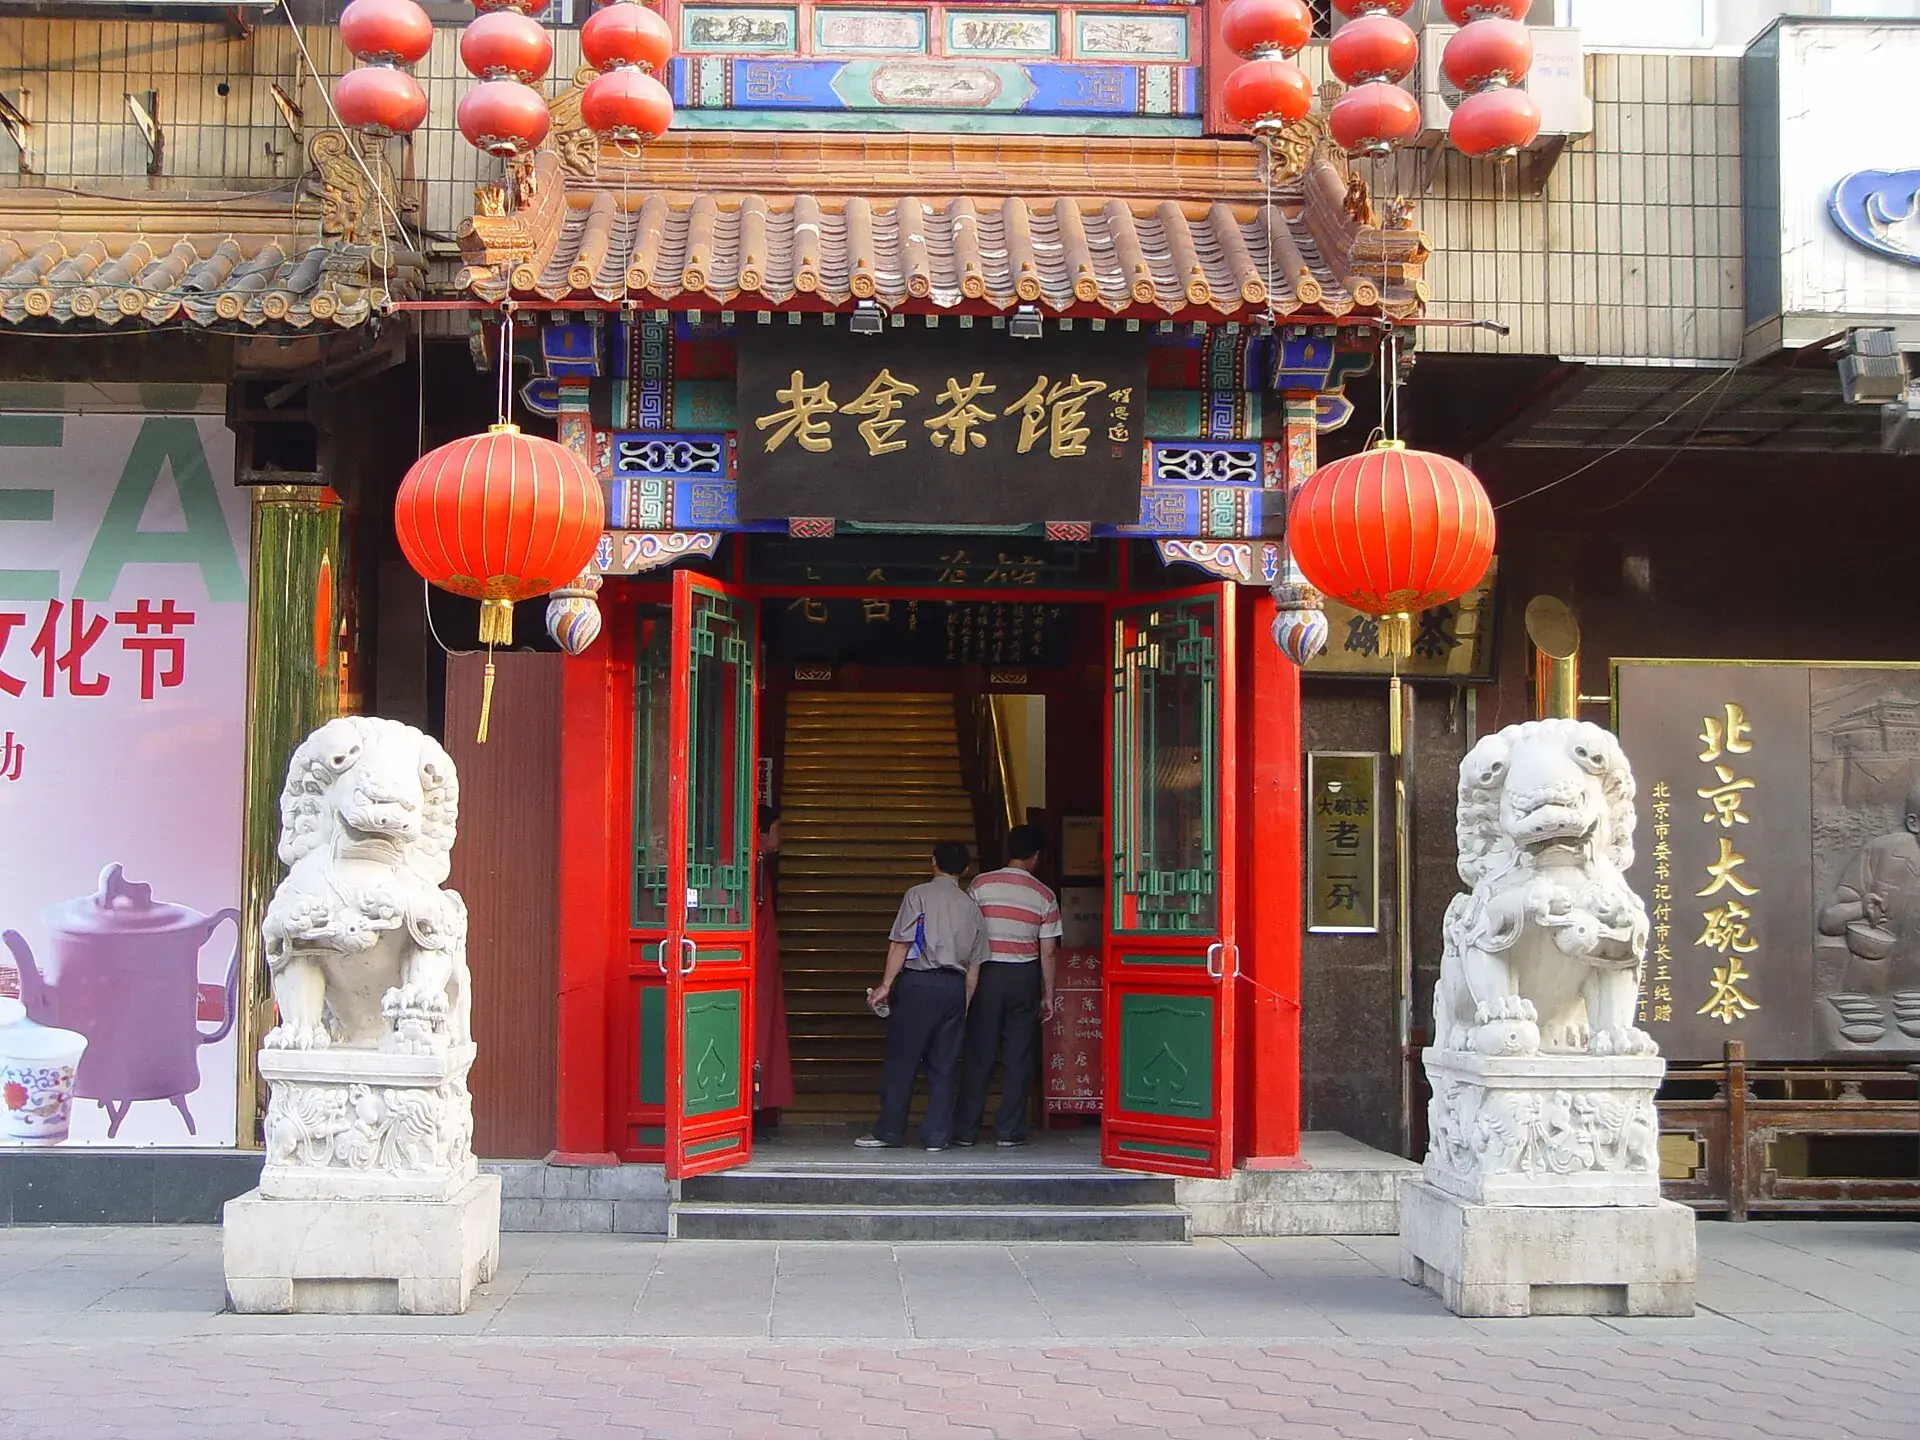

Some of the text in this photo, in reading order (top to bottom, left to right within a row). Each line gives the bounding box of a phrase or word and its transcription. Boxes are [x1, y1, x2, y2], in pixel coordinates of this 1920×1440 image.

[1317, 797, 1369, 816] 大碗茶
[1651, 781, 1673, 1022] 北京市委书记付市长王纯赠
[1695, 702, 1761, 1024] 北京大碗茶
